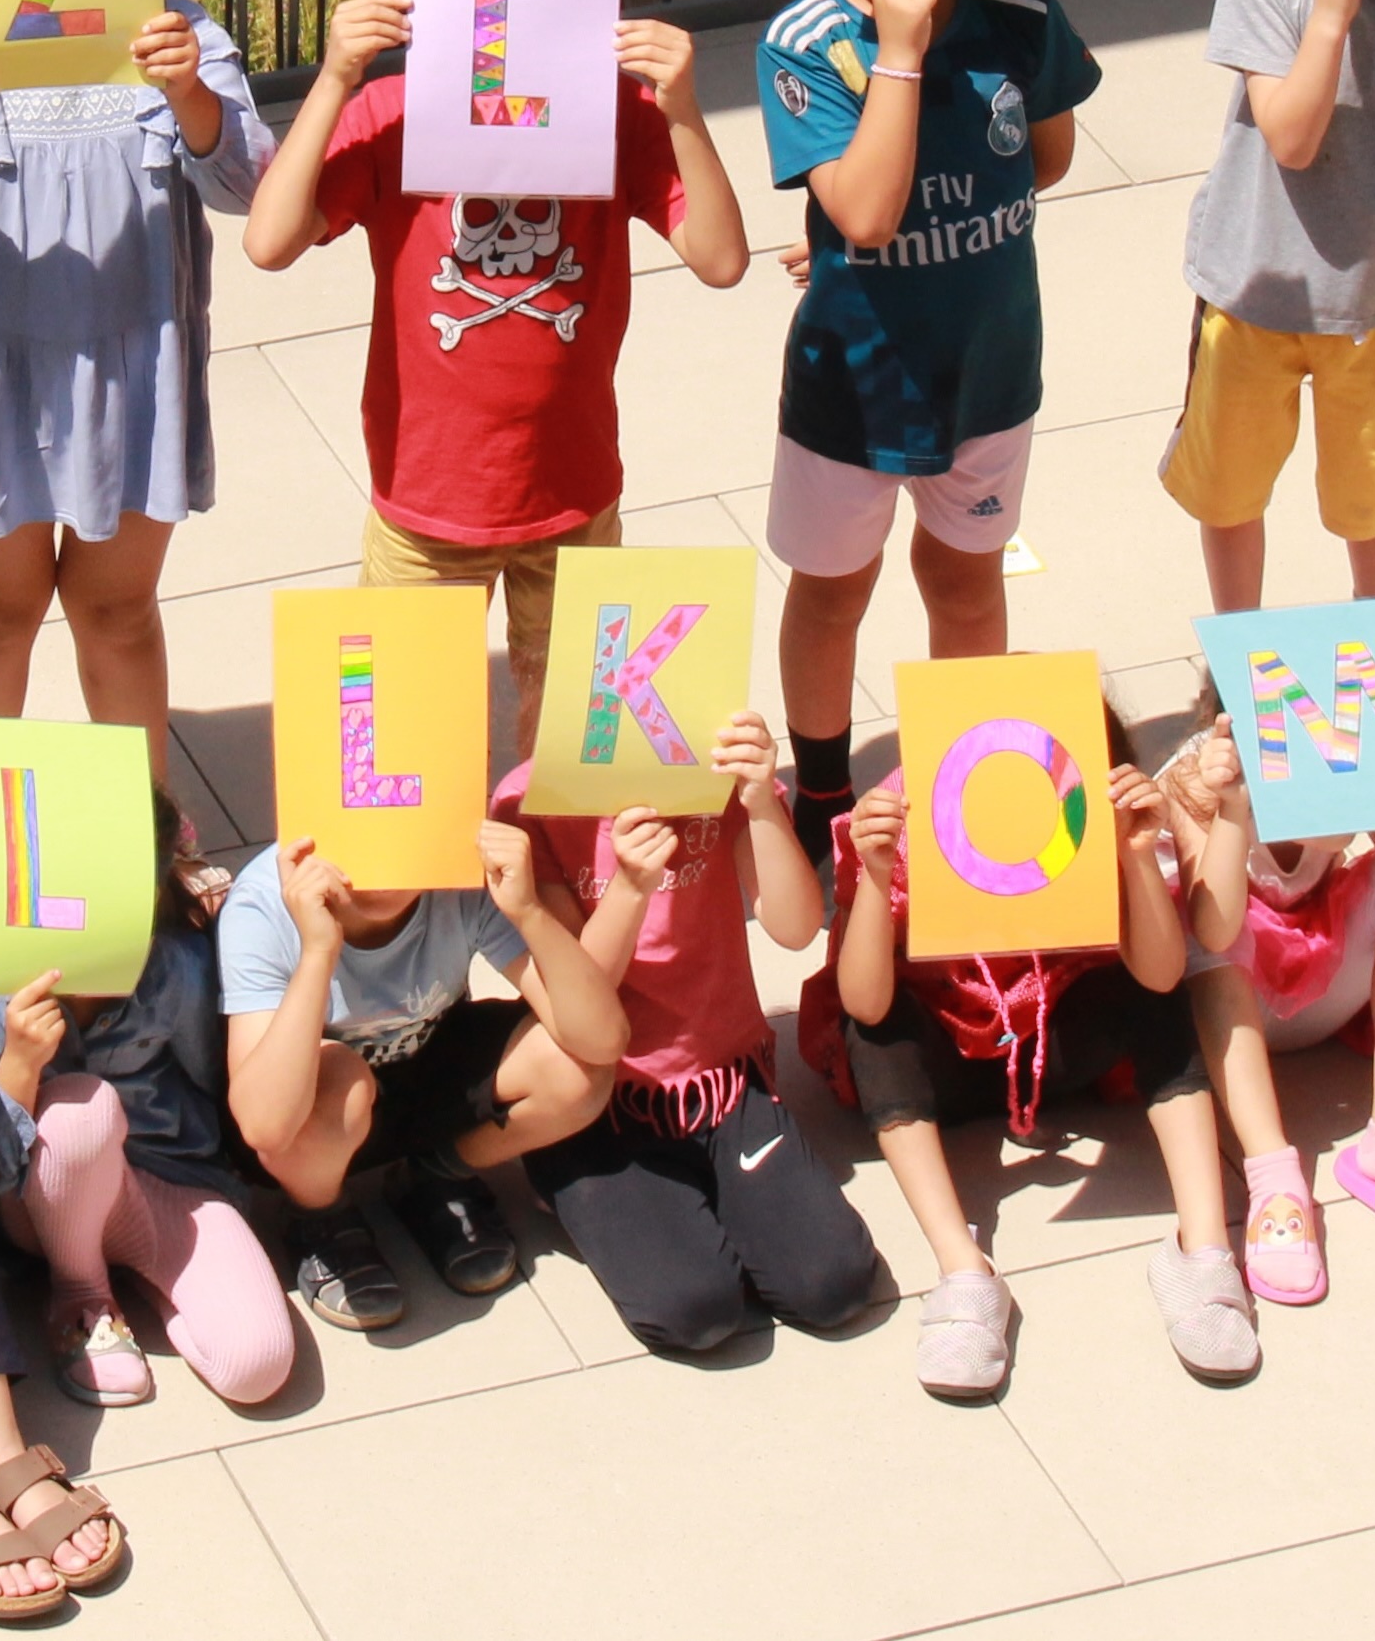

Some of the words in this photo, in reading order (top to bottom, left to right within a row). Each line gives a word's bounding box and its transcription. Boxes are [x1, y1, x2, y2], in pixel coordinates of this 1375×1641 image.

[920, 172, 974, 209] Fly
[339, 634, 422, 808] L
[579, 603, 710, 766] K
[0, 768, 87, 930] L
[932, 718, 1087, 897] O
